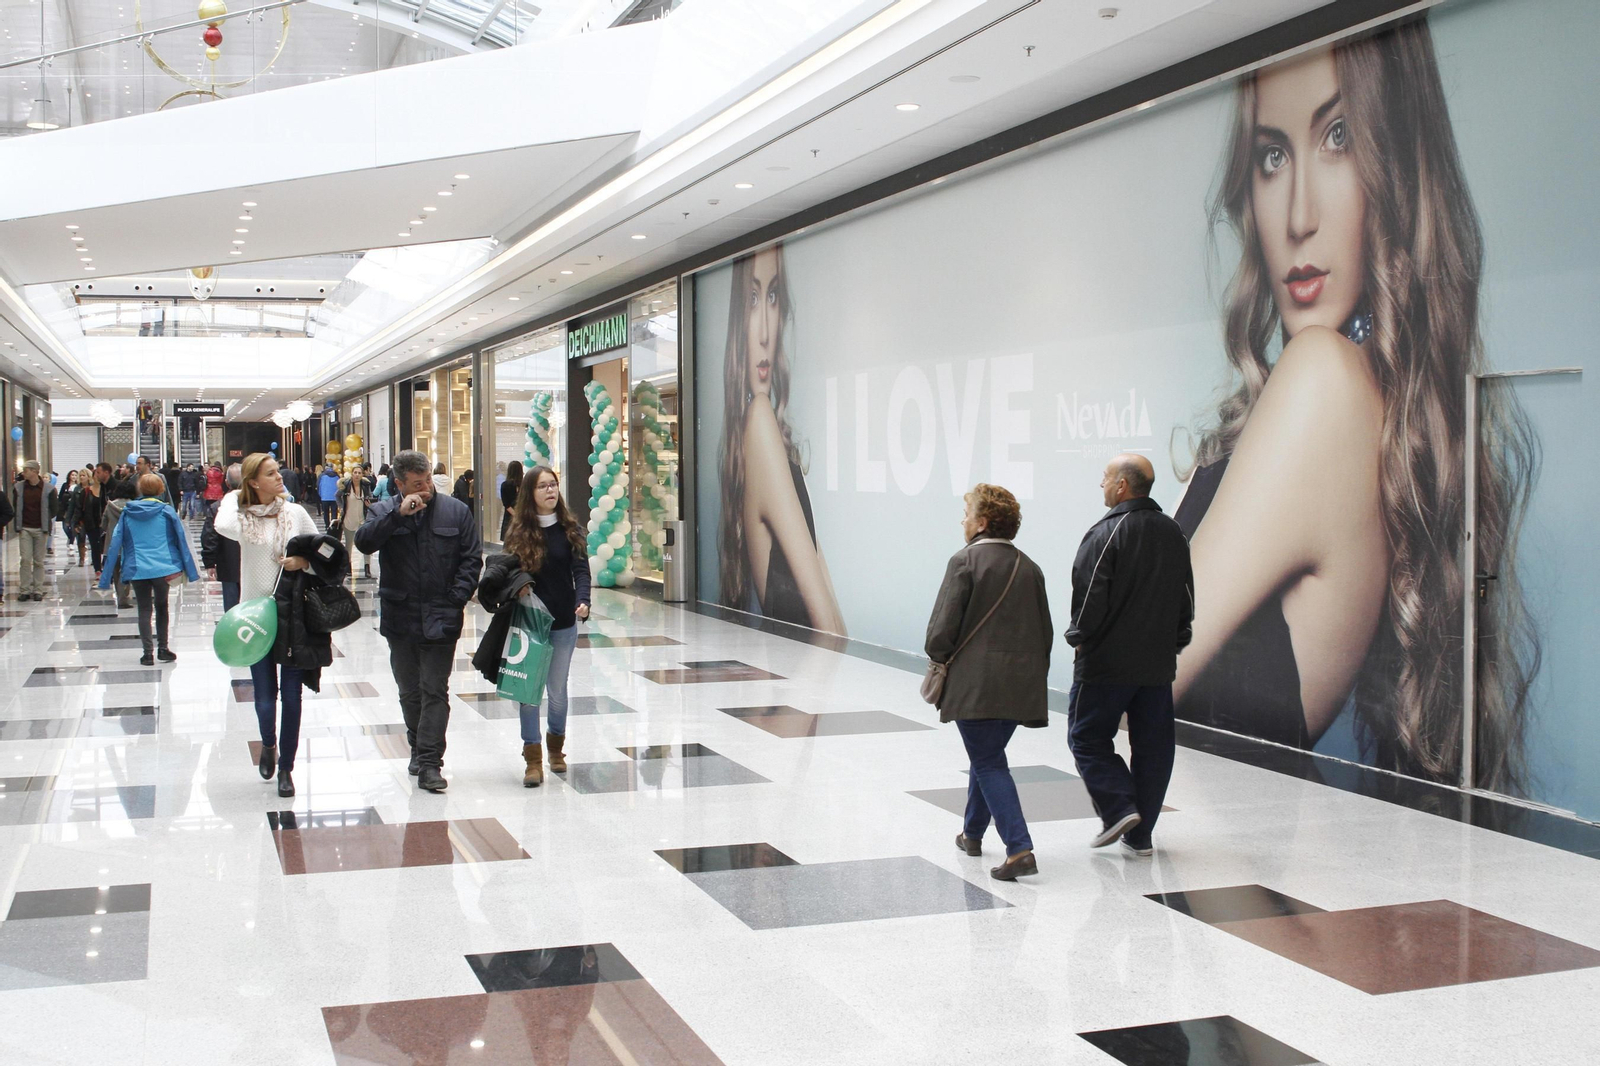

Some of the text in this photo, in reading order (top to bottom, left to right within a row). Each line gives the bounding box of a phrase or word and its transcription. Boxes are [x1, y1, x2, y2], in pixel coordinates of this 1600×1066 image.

[568, 313, 627, 360] DEICHMANN
[826, 352, 1034, 500] I LOVE
[237, 625, 255, 644] D
[501, 626, 529, 665] D
